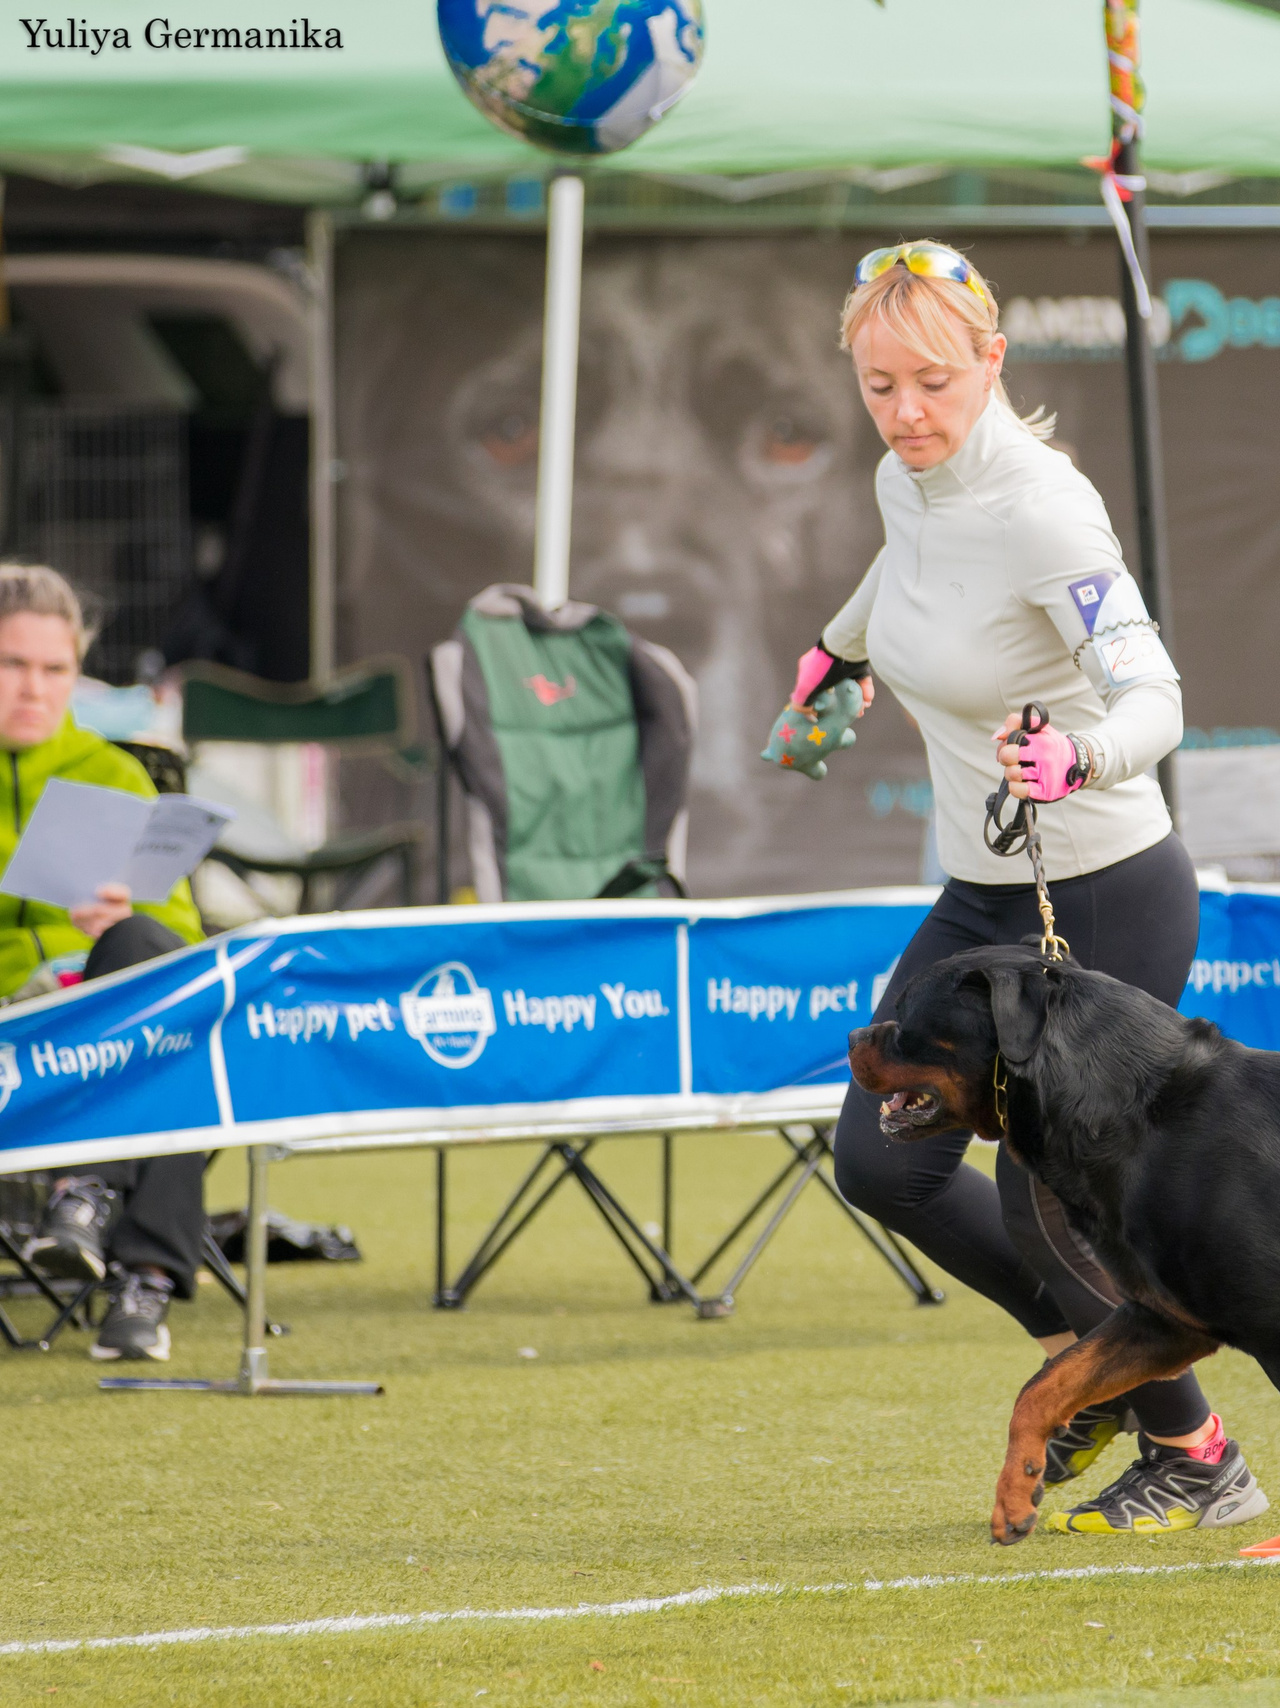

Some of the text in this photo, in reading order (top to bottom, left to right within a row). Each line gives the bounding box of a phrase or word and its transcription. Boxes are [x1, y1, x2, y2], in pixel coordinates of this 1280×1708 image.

[246, 997, 396, 1045] Happy pet
[502, 981, 670, 1034] Happy You.
[706, 977, 859, 1022] Happy pet
[31, 1038, 134, 1081] Happy
